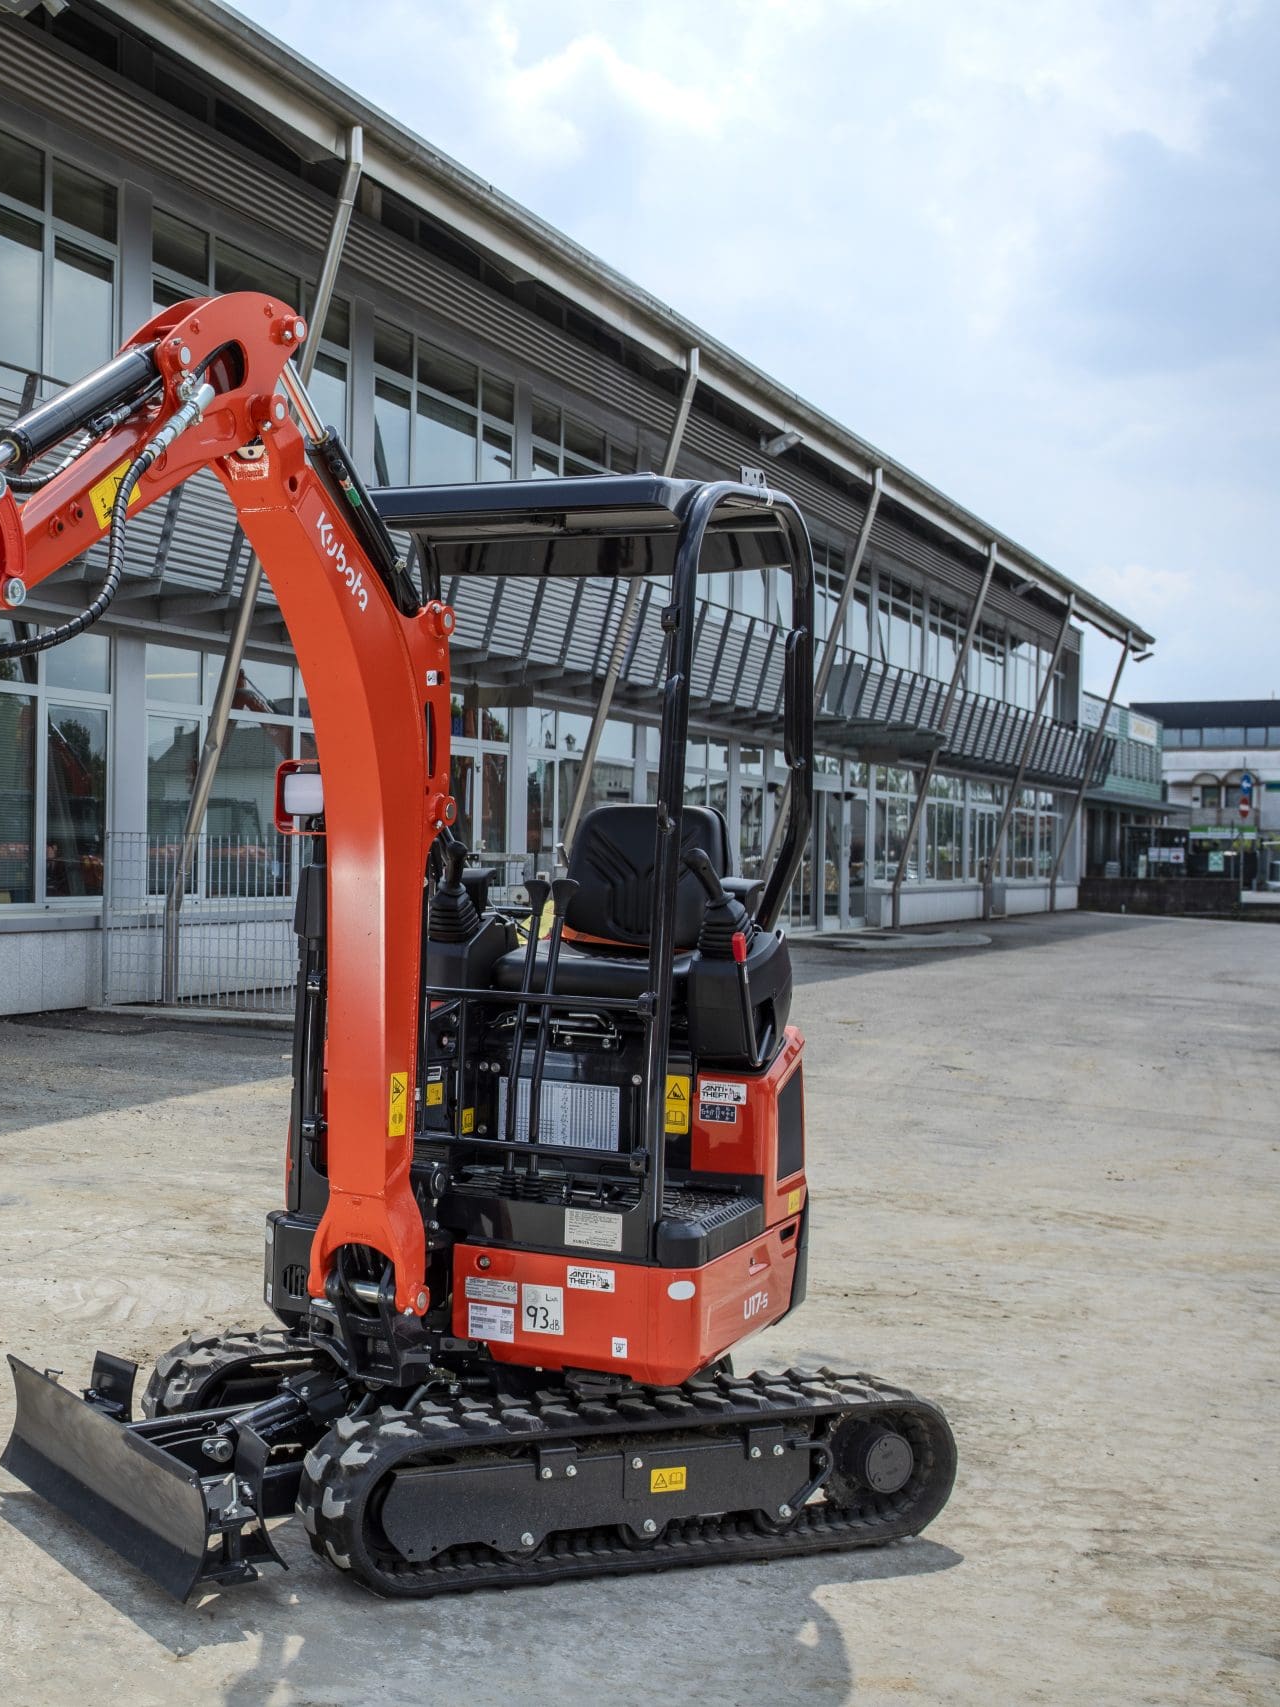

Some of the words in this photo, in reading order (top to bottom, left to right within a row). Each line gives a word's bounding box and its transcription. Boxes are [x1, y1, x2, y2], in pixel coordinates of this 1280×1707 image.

[316, 511, 368, 612] Kubota
[701, 1091, 728, 1099] THEFT
[568, 1277, 596, 1287] THEFT
[526, 1305, 549, 1330] 93
[549, 1319, 560, 1331] dB
